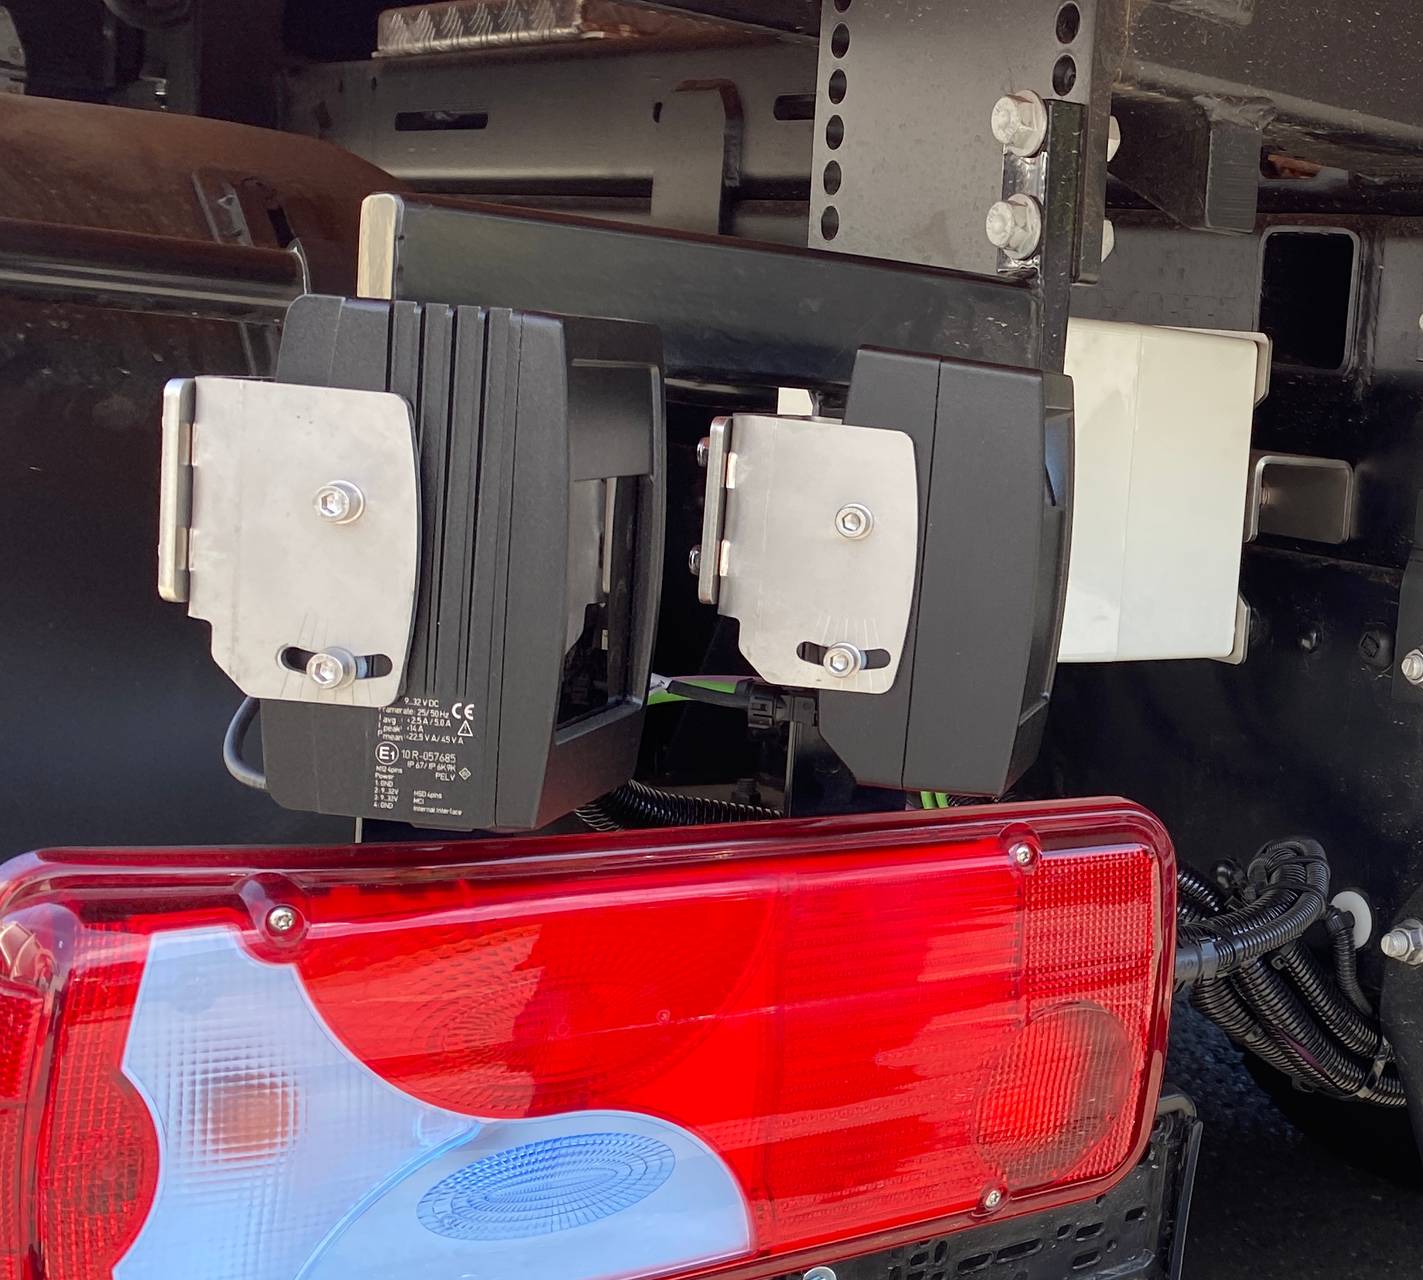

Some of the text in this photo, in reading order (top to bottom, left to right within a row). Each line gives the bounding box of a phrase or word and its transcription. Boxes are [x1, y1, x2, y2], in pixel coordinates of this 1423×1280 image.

[428, 699, 439, 707] DC
[451, 702, 475, 720] CE
[374, 772, 394, 780] Power
